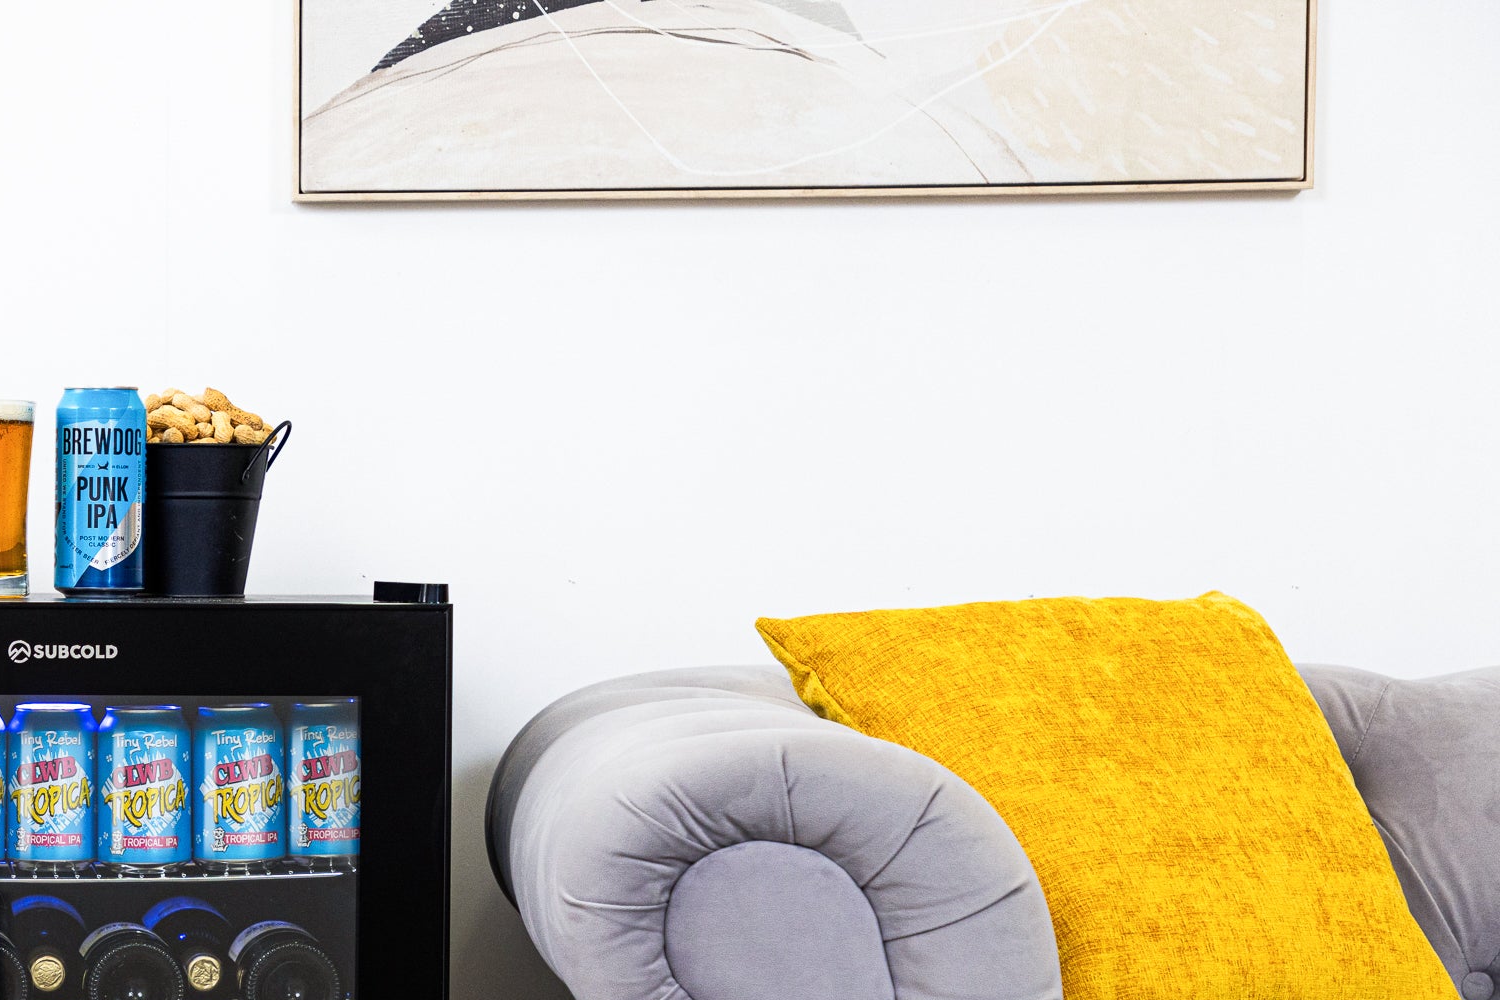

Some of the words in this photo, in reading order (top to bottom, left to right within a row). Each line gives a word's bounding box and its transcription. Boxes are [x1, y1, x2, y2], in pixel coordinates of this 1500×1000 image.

[63, 428, 142, 456] BREWDOG
[77, 476, 128, 502] PUNK
[88, 503, 118, 529] IPA
[104, 548, 130, 566] FERCELY
[33, 644, 118, 659] SUBCOLD
[18, 731, 43, 752] Tiny
[45, 731, 81, 746] Rebel
[112, 732, 140, 755] Tiny
[143, 733, 178, 749] Rebel
[211, 730, 243, 752] Tiny
[243, 728, 276, 743] Rebel
[295, 726, 324, 748] Tiny
[326, 725, 358, 741] Rebe
[17, 756, 77, 785] CLWB
[112, 758, 173, 789] CLWB
[212, 754, 273, 786] CLWB
[297, 749, 358, 782] CLWB
[11, 777, 91, 825] TROPICA
[104, 779, 185, 827] TROPICA
[203, 774, 283, 824] TROPICA
[290, 775, 360, 820] TROPIC
[27, 835, 66, 845] TROPICAL
[68, 835, 81, 844] IPA
[123, 837, 164, 847] TROPICAL
[166, 836, 178, 846] IPA
[224, 834, 265, 844] TROPICAL
[267, 832, 278, 842] IPA
[308, 829, 349, 840] TROPICAL
[351, 828, 359, 839] IP
